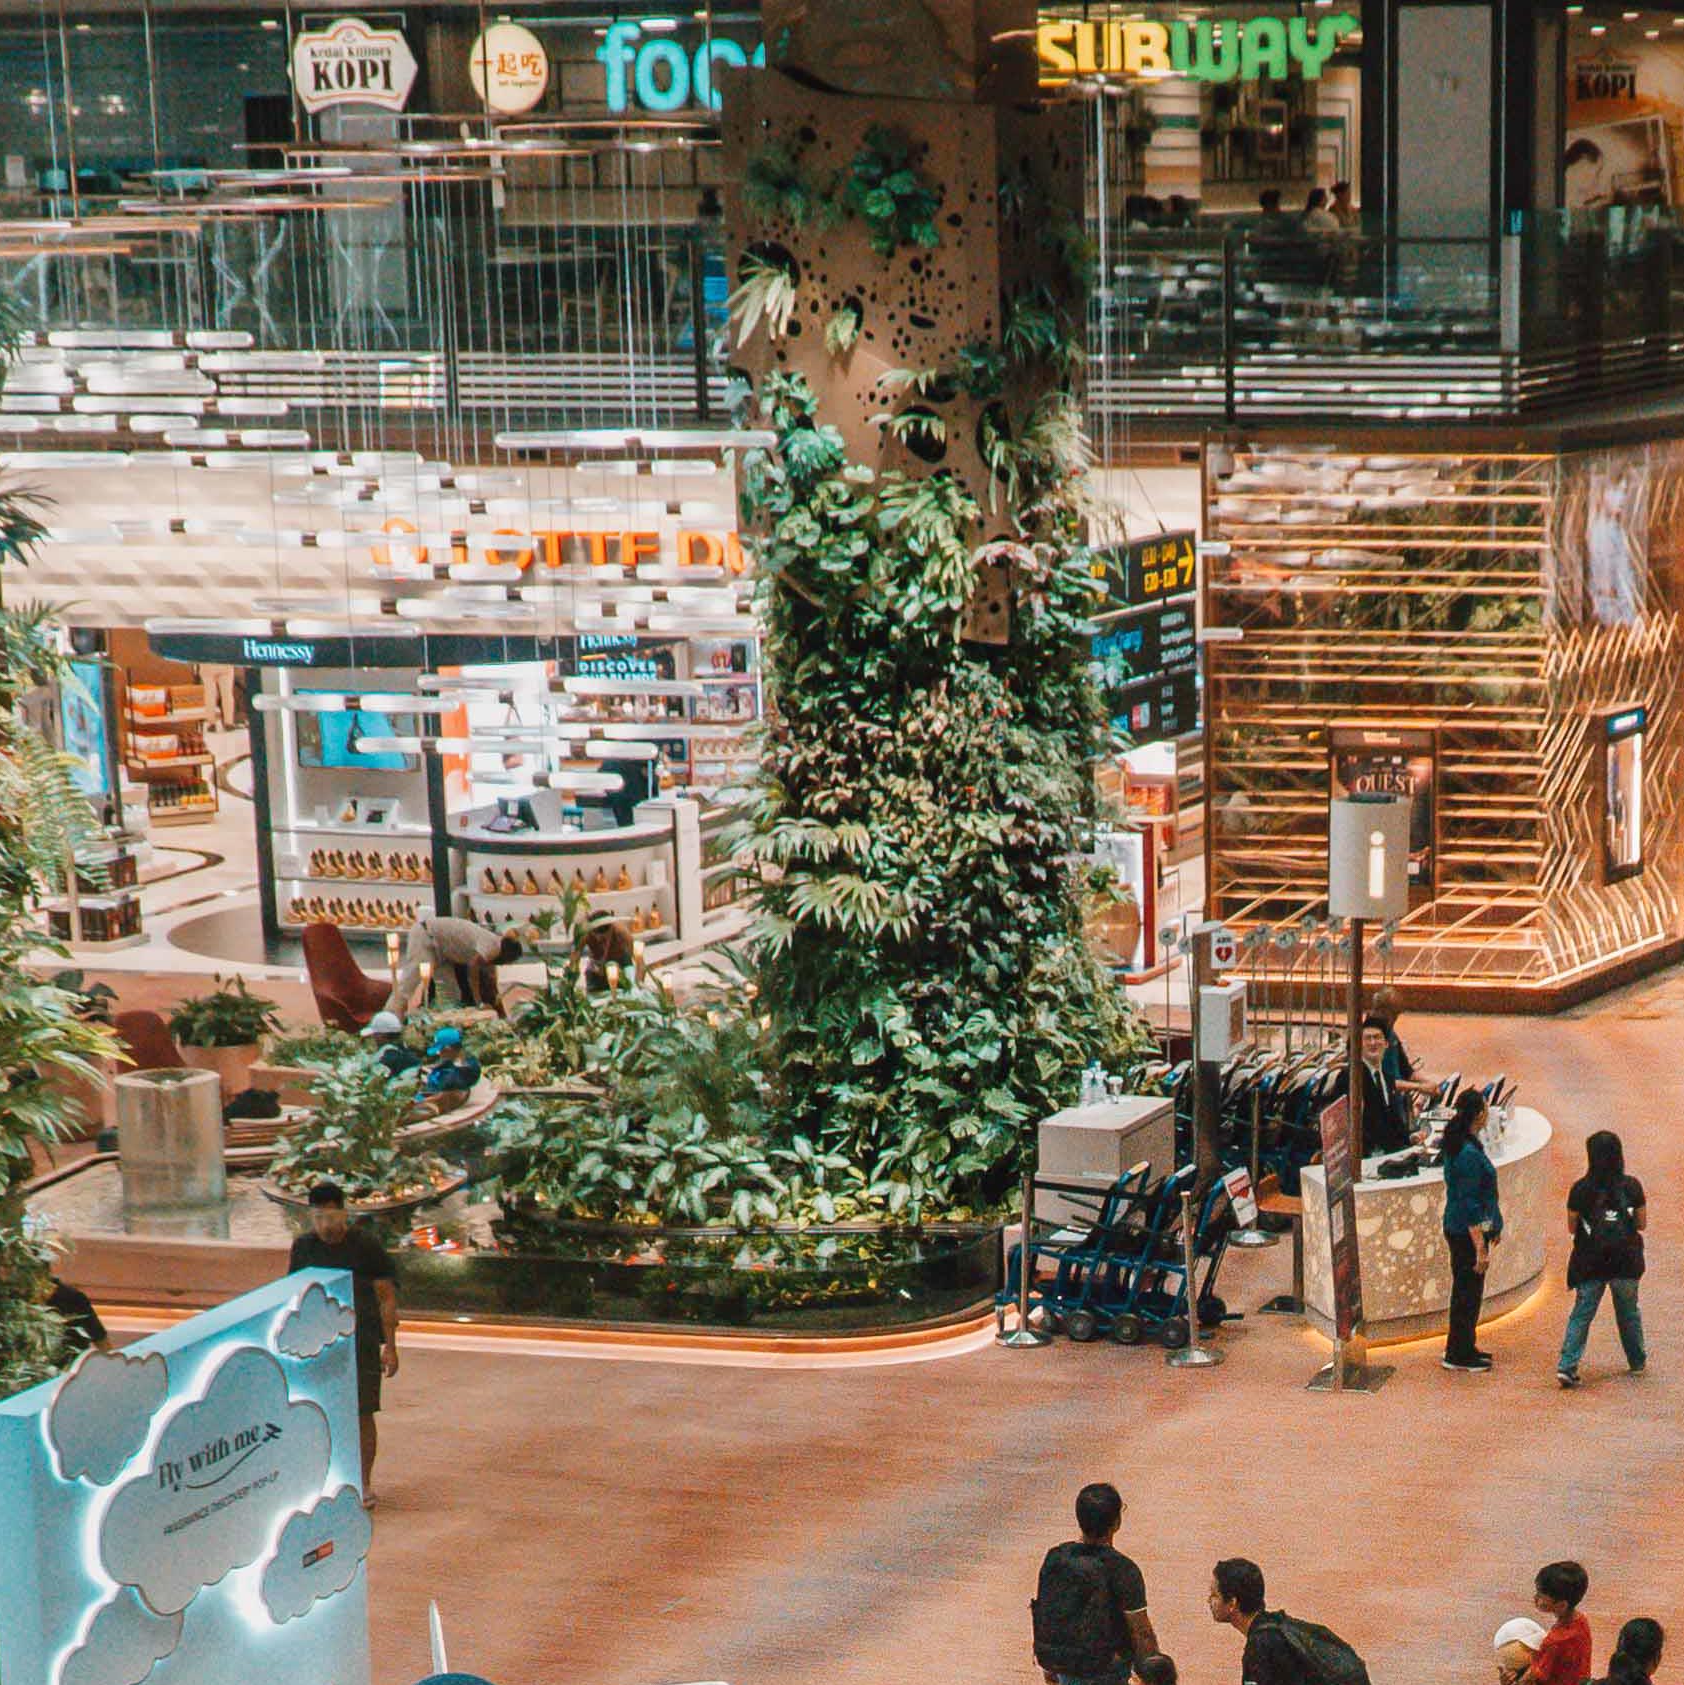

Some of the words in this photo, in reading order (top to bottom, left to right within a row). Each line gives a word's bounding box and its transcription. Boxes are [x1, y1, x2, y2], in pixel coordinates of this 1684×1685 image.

[596, 21, 765, 112] foo
[1037, 13, 1361, 82] SUBWAY
[312, 57, 394, 92] KOPI
[243, 638, 315, 665] Hennessy
[1356, 774, 1416, 794] QUEST
[157, 1460, 184, 1493] Fly
[188, 1436, 231, 1474] with
[233, 1424, 261, 1451] me
